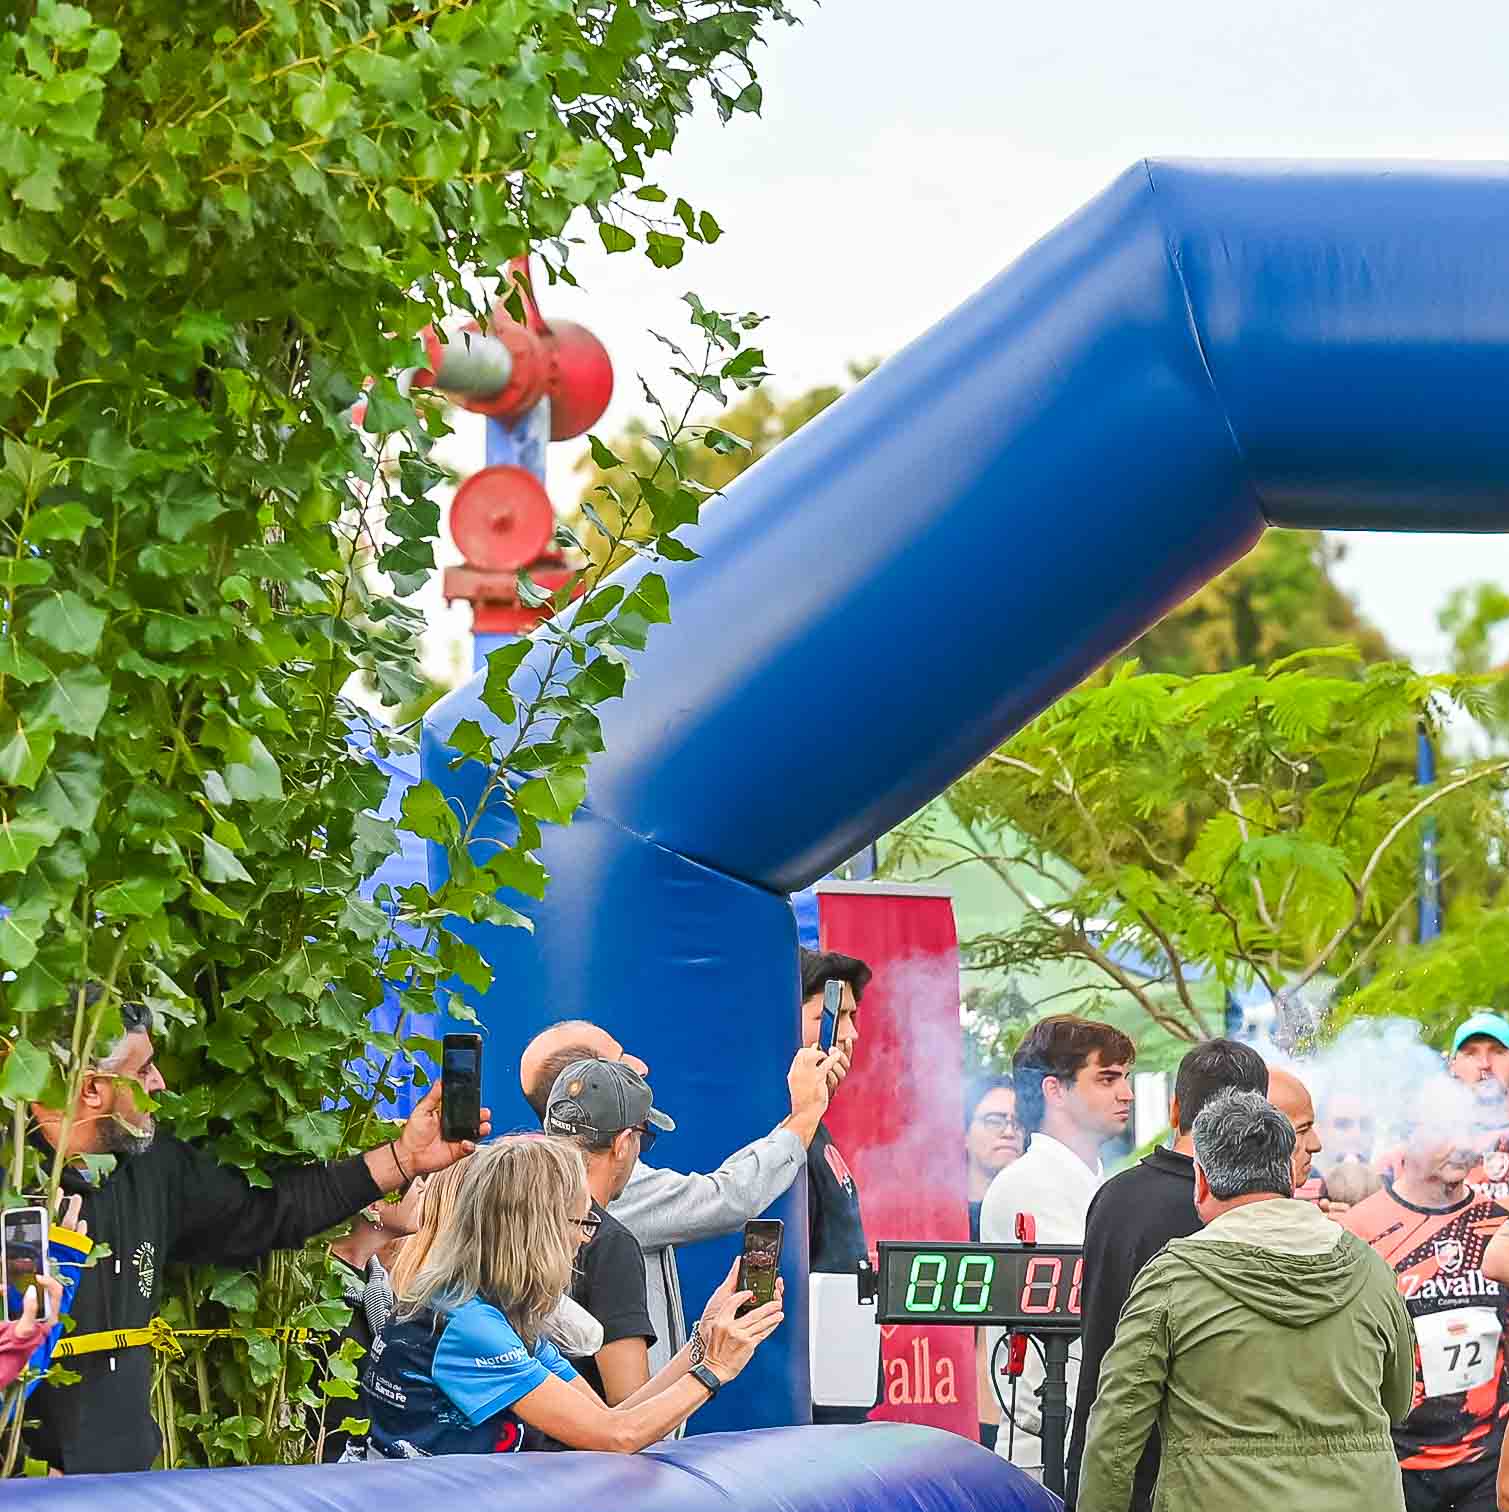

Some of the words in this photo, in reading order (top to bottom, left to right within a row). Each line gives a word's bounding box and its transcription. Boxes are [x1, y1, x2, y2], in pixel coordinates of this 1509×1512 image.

[905, 1254, 995, 1313] 00
[1400, 1269, 1500, 1300] Zavalla
[1443, 1341, 1481, 1372] 72
[374, 1381, 395, 1400] Santa
[395, 1392, 407, 1402] Fe
